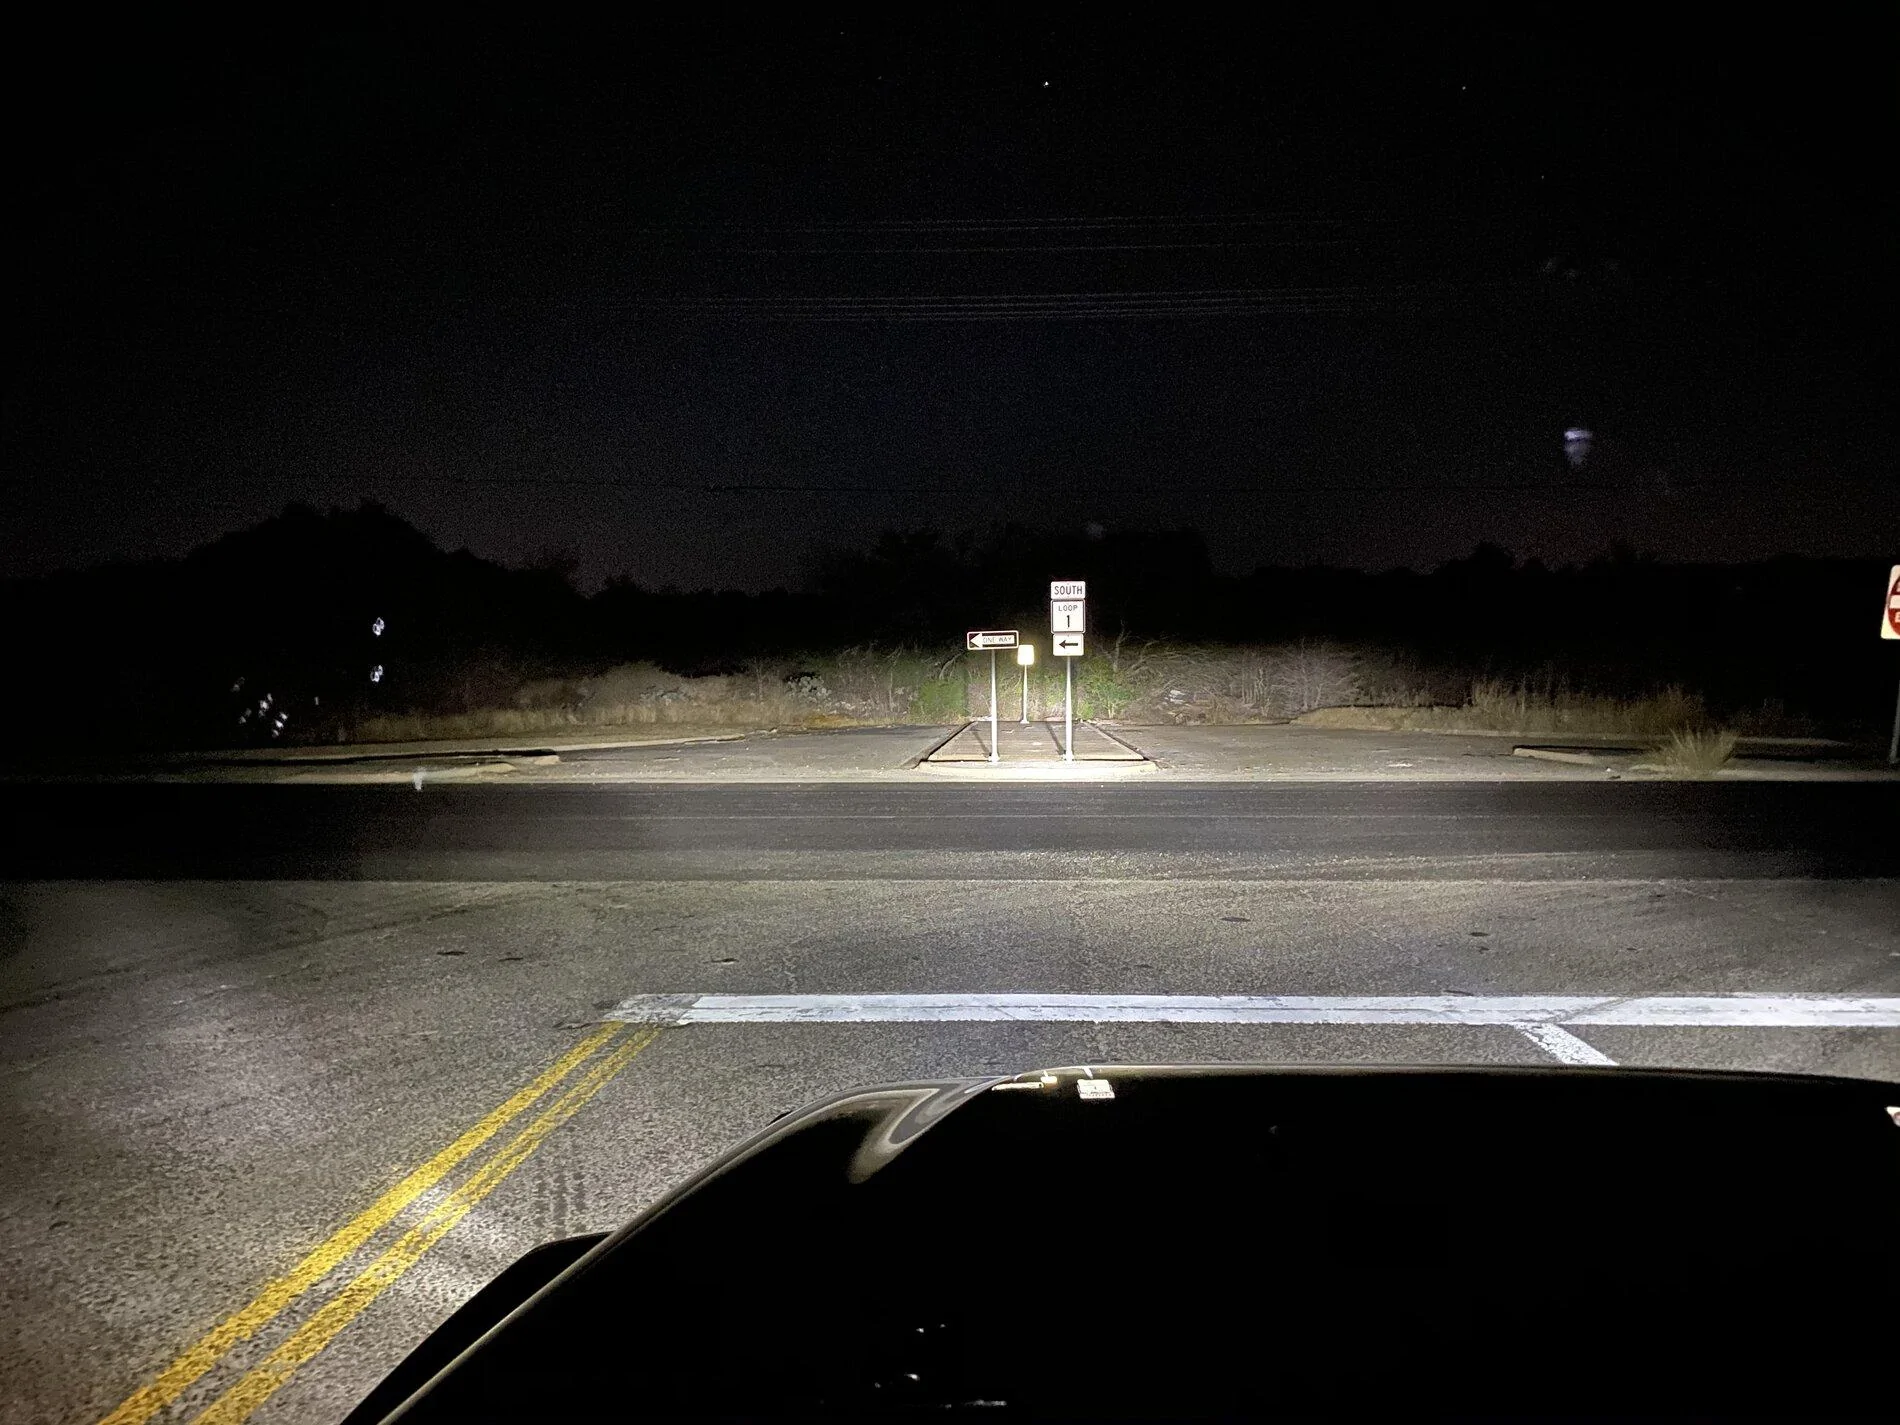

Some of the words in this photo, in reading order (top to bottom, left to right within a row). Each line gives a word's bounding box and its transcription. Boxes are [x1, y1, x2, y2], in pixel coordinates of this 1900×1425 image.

[1054, 585, 1083, 595] SOUTH
[1058, 604, 1078, 612] LOOP
[1066, 614, 1070, 628] 1
